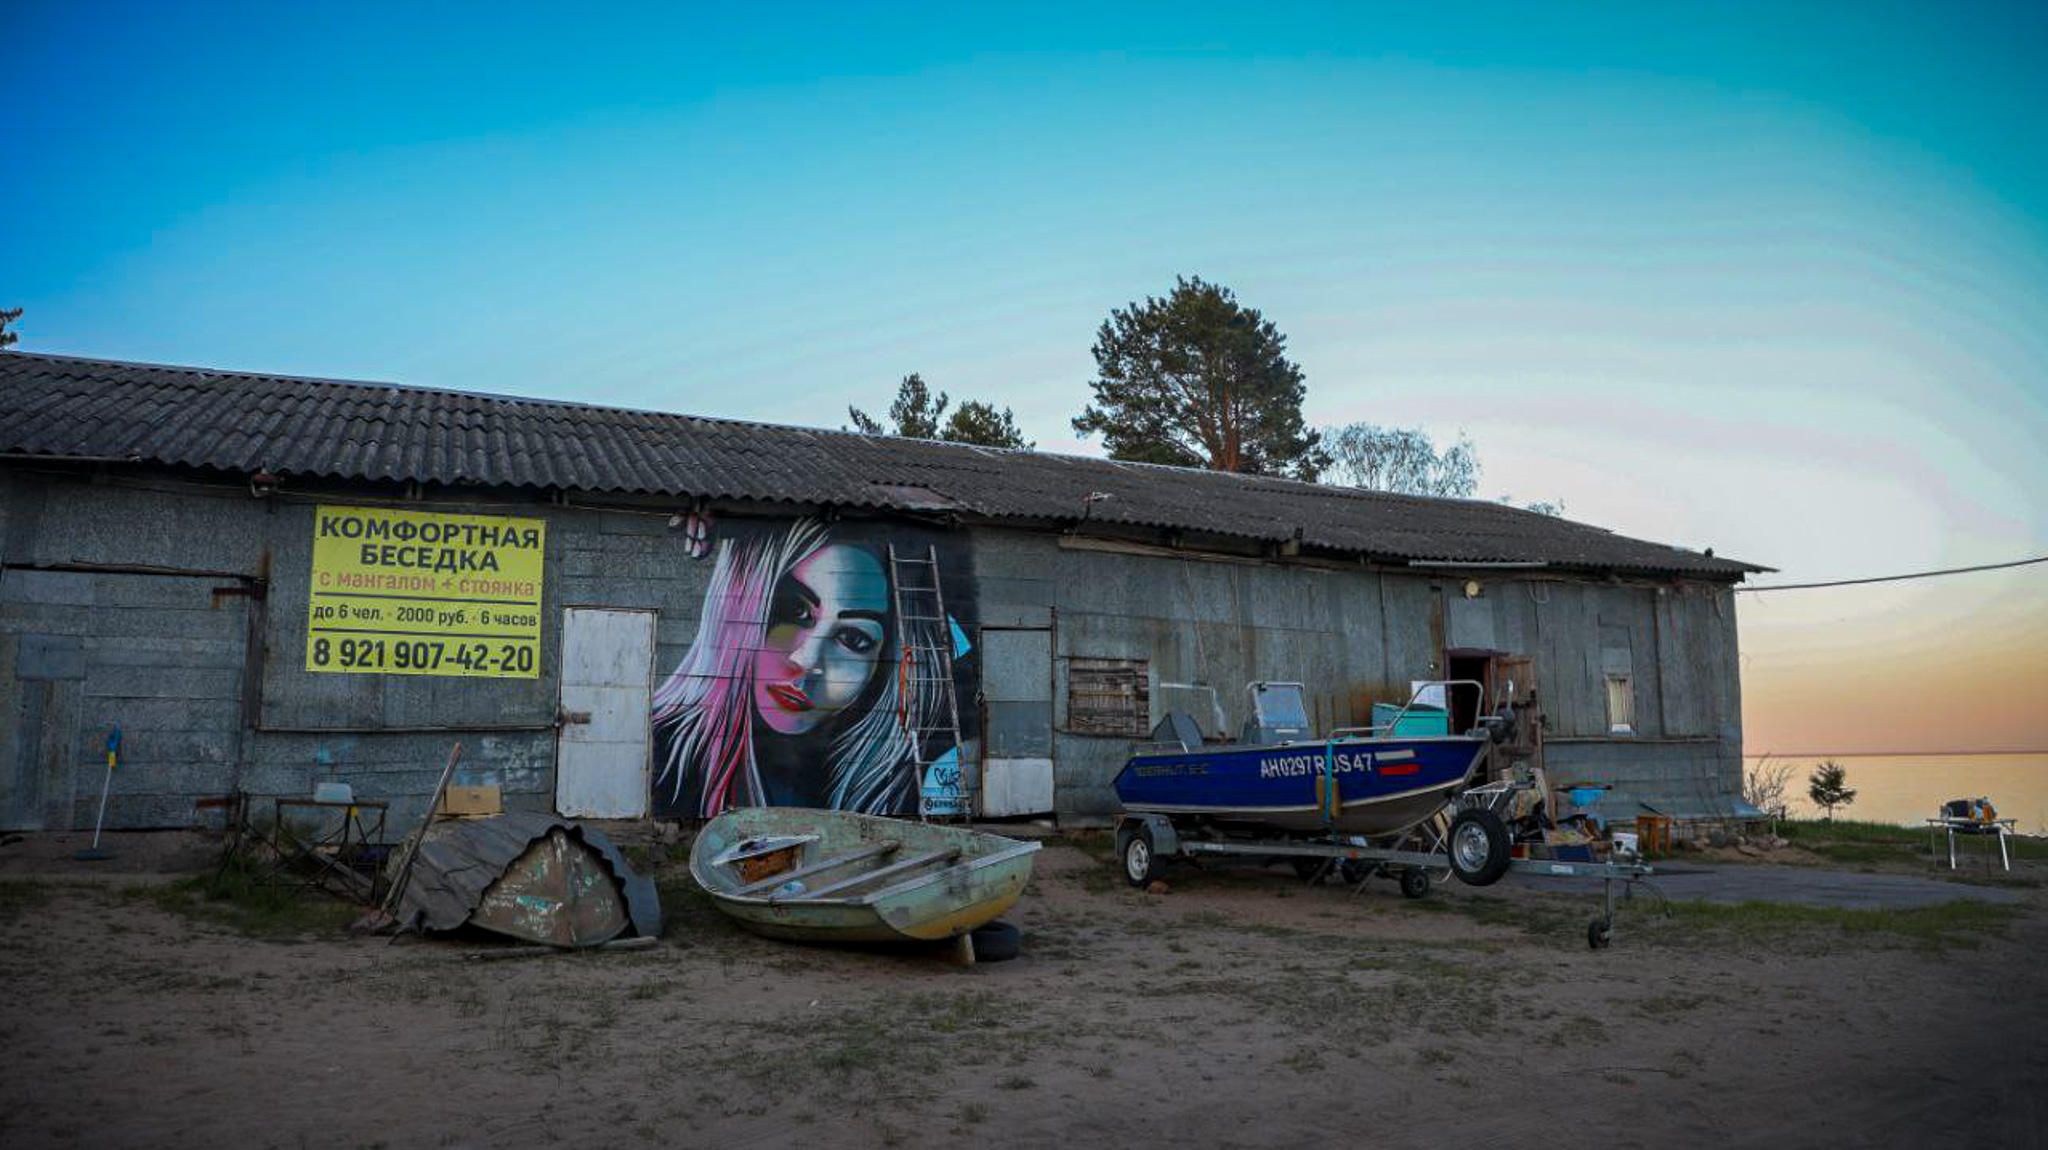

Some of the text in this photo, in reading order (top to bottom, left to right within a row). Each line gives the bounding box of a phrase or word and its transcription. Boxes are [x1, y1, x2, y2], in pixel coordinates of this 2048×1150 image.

[321, 515, 539, 549] КОМФОРТНАЯ
[361, 544, 499, 573] БЕСЕДКА
[320, 571, 535, 596] с мангалом + стоянка
[314, 604, 537, 626] до 6 чел. 2000 руб. 6 часов
[314, 638, 533, 672] 8 921 907-42-20
